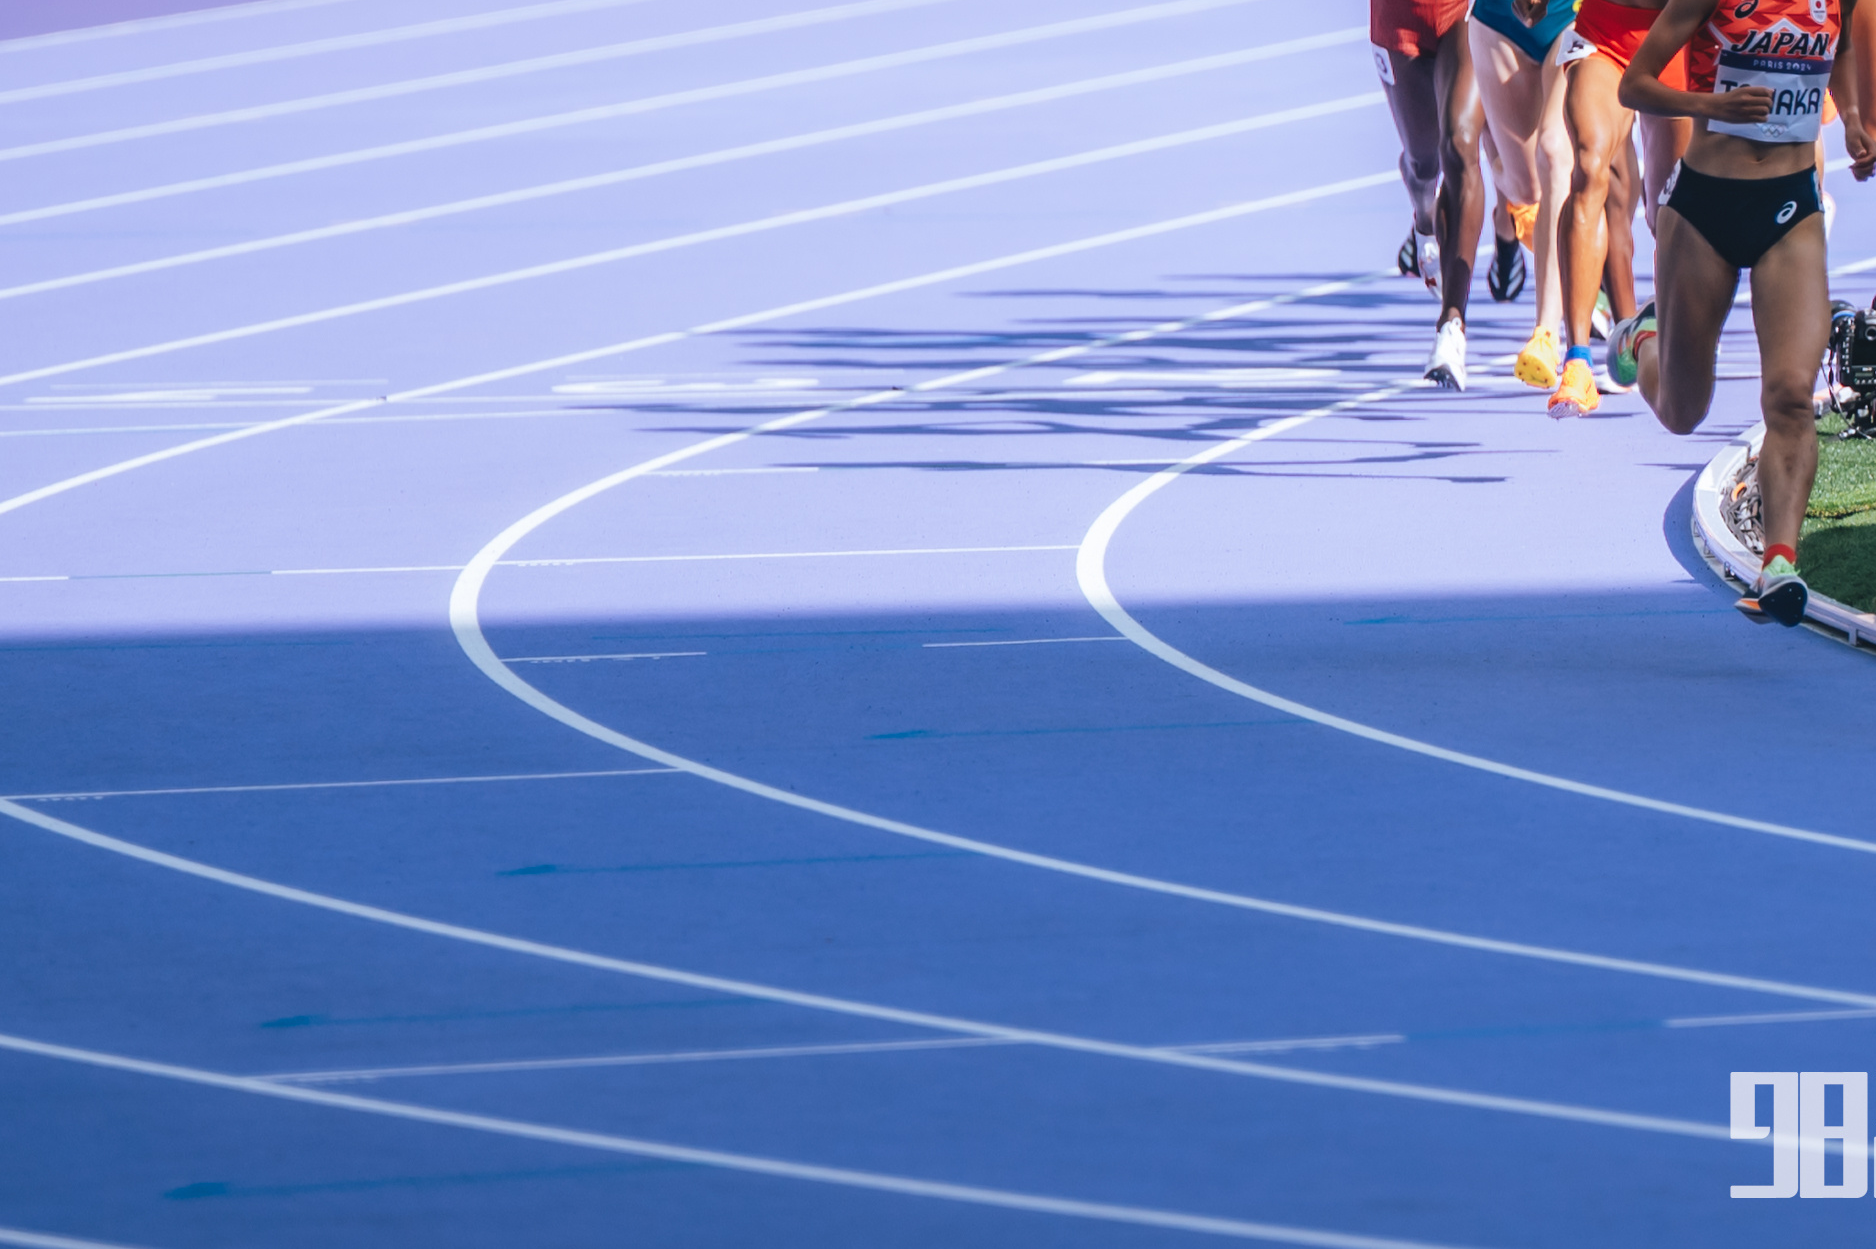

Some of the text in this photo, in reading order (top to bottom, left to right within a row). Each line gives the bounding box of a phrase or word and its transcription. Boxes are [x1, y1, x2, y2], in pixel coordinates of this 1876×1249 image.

[1731, 30, 1830, 56] JAPAN
[1753, 59, 1812, 72] PARIS 2024
[1720, 79, 1822, 116] TAKA
